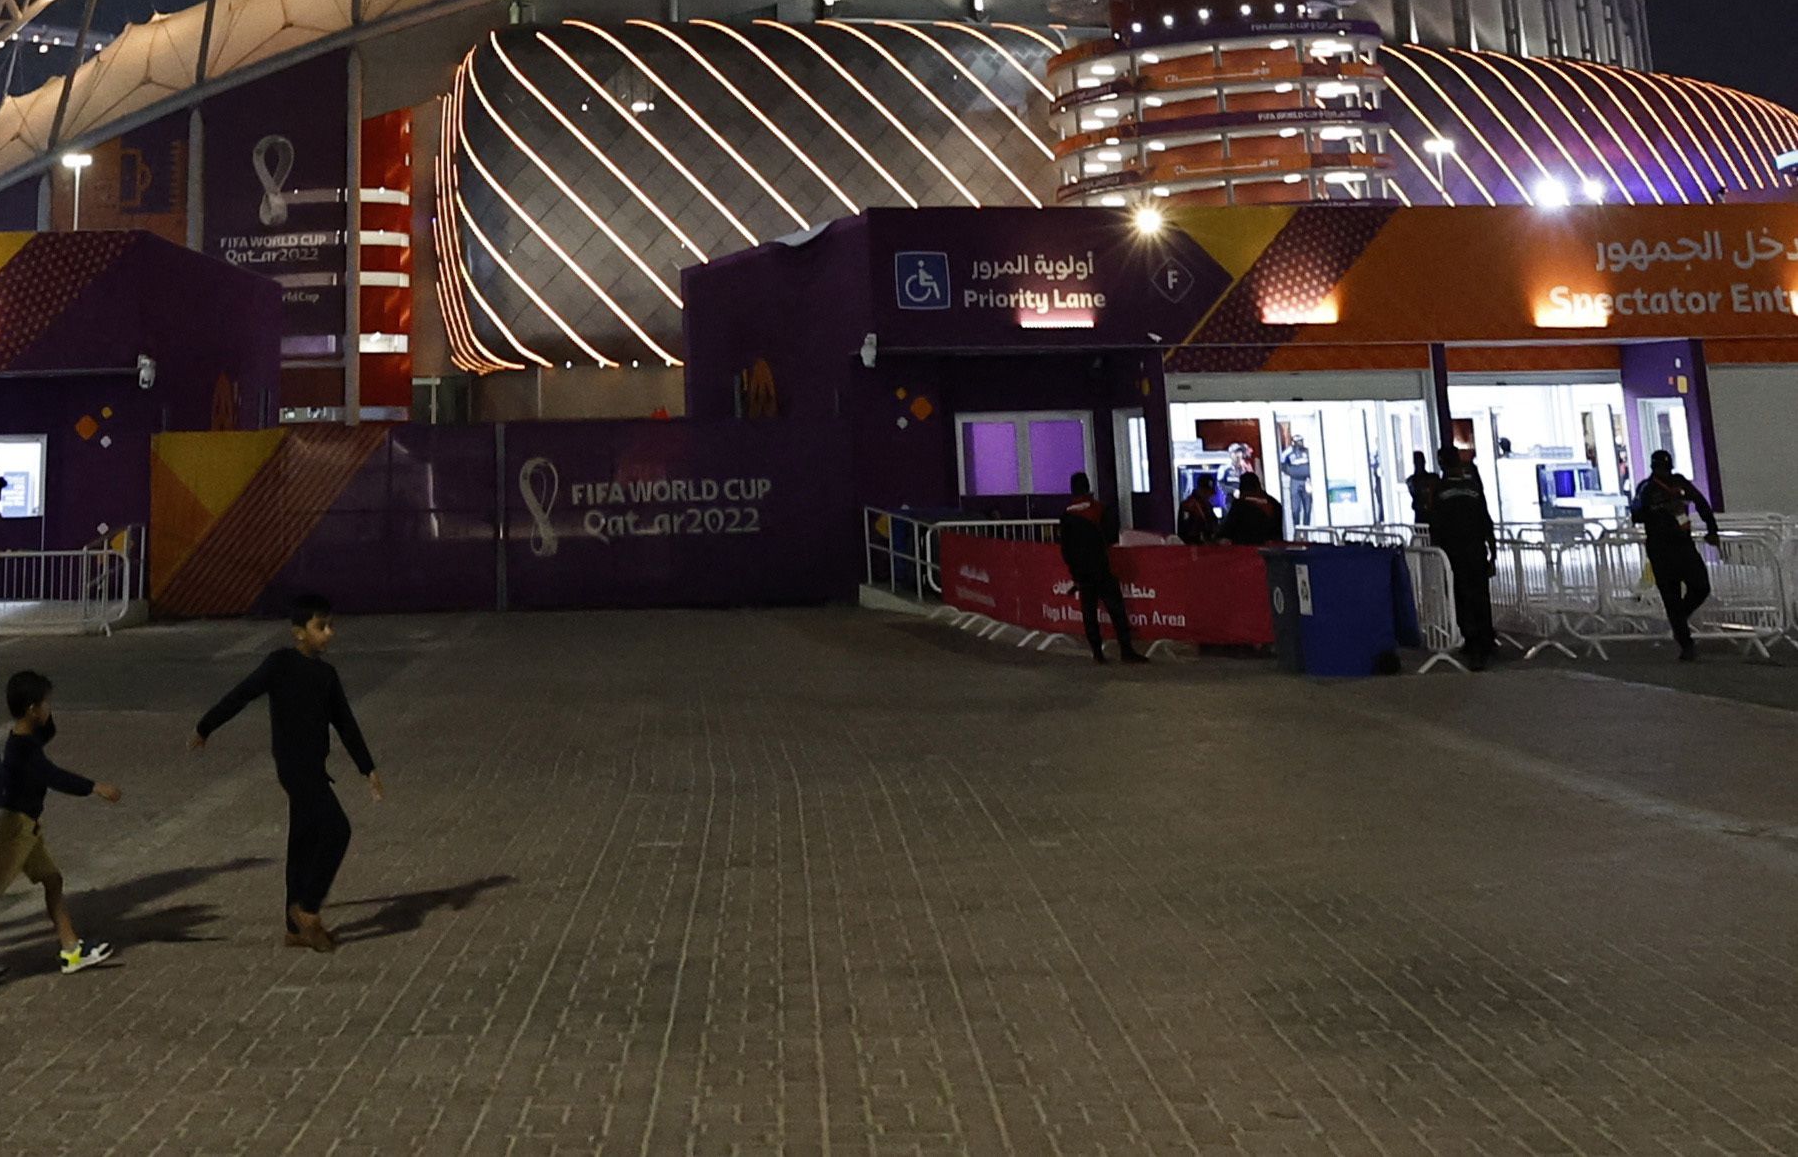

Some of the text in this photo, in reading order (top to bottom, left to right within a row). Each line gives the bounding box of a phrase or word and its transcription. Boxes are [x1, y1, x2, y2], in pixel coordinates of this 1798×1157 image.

[220, 233, 327, 248] FIFA WORLD CUP
[1596, 227, 1798, 271] دخل الجمهور
[972, 251, 1094, 280] أولوية المرور
[1167, 271, 1178, 289] F
[964, 289, 1106, 314] Priority Lane
[1549, 285, 1722, 317] Spectator
[571, 478, 772, 505] FIFA WORLD CUP
[1152, 610, 1186, 627] Area
